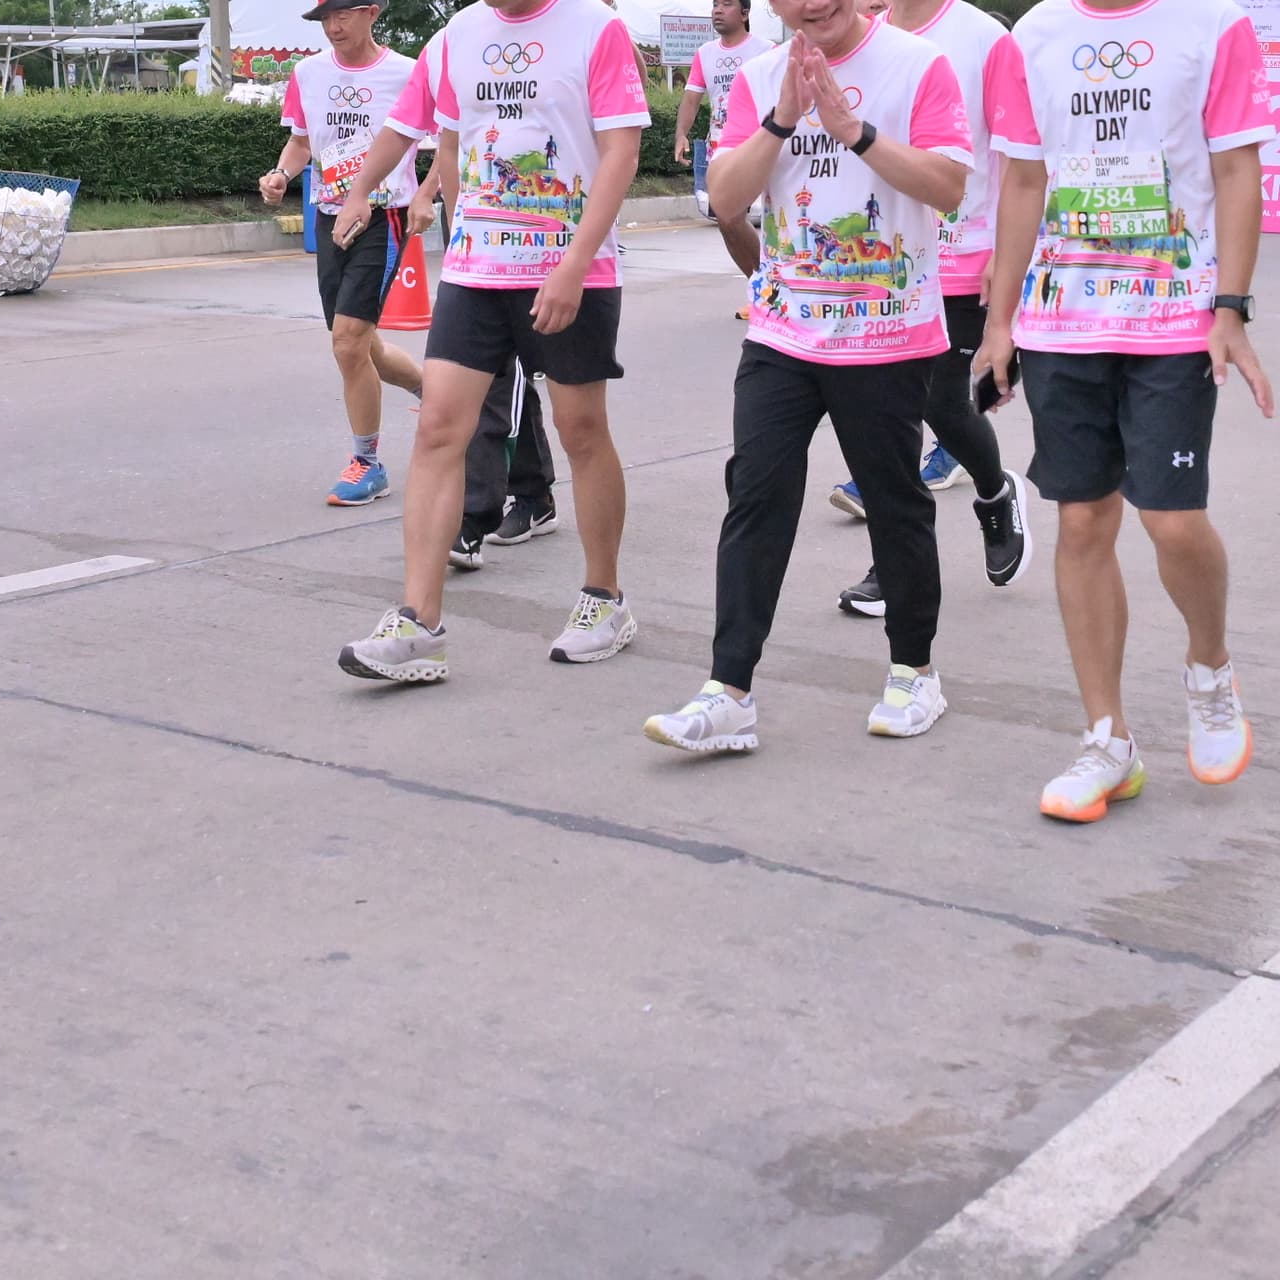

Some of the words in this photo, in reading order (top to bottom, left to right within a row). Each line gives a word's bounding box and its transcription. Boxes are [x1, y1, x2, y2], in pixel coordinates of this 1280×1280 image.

[476, 80, 538, 100] OLYMPIC
[1071, 87, 1151, 116] OLYMPIC
[326, 111, 370, 128] OLYMPIC
[496, 103, 523, 120] DAY
[337, 127, 356, 140] DAY
[1096, 116, 1128, 142] DAY
[334, 155, 364, 177] 2329
[809, 156, 839, 178] DAY
[1095, 155, 1129, 167] OLYMPIC
[1095, 168, 1111, 177] DAY
[1080, 187, 1137, 208] 7584
[1113, 220, 1136, 234] 5.8
[1141, 218, 1167, 233] KM
[506, 265, 523, 274] BUT
[526, 266, 541, 274] THE
[800, 300, 905, 319] SUPHANBURI
[1149, 301, 1195, 319] 2025
[864, 318, 907, 337] 2025
[1130, 320, 1150, 331] THE
[1151, 320, 1199, 332] JOURNEY
[825, 339, 843, 348] BUT
[846, 338, 865, 348] THE
[867, 335, 909, 348] JOURNEY
